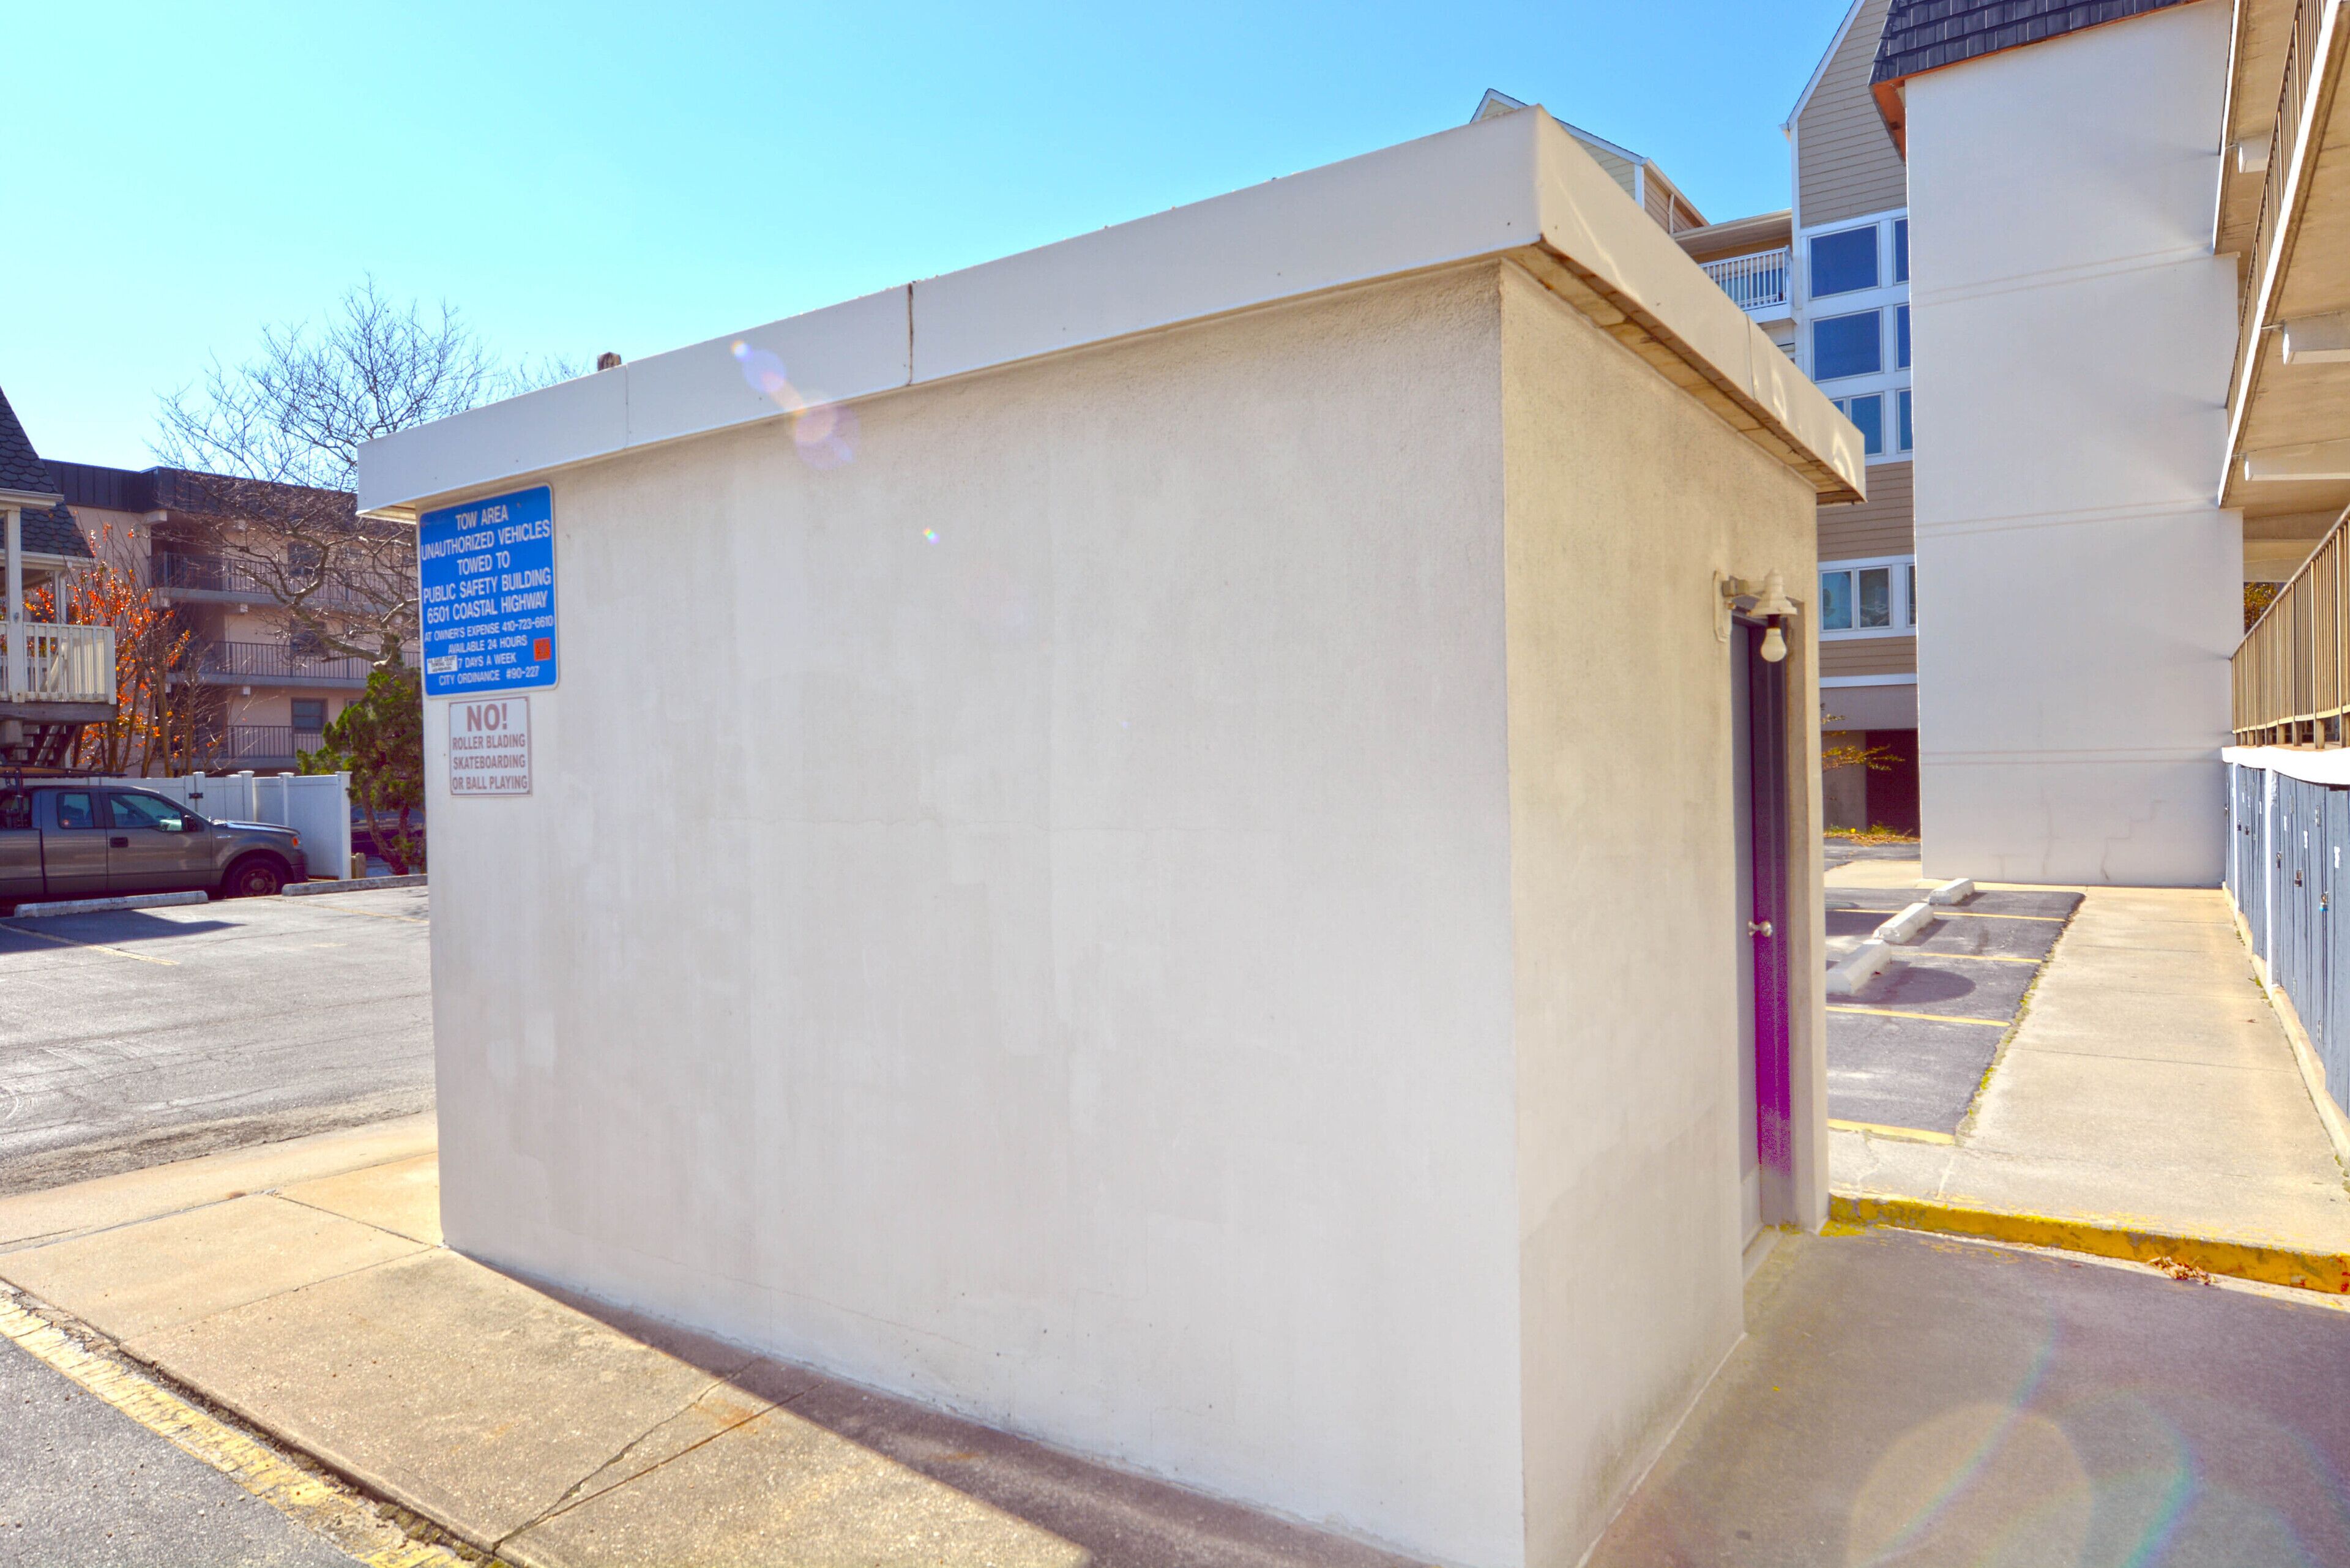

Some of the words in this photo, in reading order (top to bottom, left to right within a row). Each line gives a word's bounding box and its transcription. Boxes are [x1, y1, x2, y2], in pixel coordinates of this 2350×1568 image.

[455, 511, 477, 531] TOW
[481, 504, 509, 526] AREA
[421, 531, 494, 561] UNAUTHORIZED
[498, 520, 550, 545] VEHICLES
[457, 554, 493, 575] TOWED
[496, 551, 510, 569] TO
[423, 583, 456, 604] PUBLIC
[460, 576, 498, 598] SAFETY
[501, 567, 551, 591] BUILDING
[427, 605, 450, 624] 6501
[452, 599, 498, 621] COASTAL
[501, 591, 548, 613] HIGHWAY
[424, 631, 432, 642] AT
[434, 627, 464, 641] OWNER'S
[468, 622, 500, 637] EXPENSE
[502, 615, 554, 632] 410-723-6610
[448, 640, 485, 654] AVAILABLE
[488, 639, 498, 650] 24
[500, 635, 528, 648] HOURS
[458, 659, 463, 668] 7
[465, 655, 484, 668] DAYS
[487, 655, 493, 665] A
[494, 652, 517, 664] WEEK
[439, 674, 455, 686] CITY
[457, 670, 500, 684] ORDINANCE
[506, 665, 540, 679] #90-227
[467, 703, 507, 732] NO!
[452, 736, 483, 750] ROLLER
[487, 734, 525, 749] BLADING
[453, 754, 525, 770] SKATEBOARDING
[452, 777, 464, 790] OR
[466, 776, 487, 790] BALL
[490, 775, 528, 790] PLAYING
